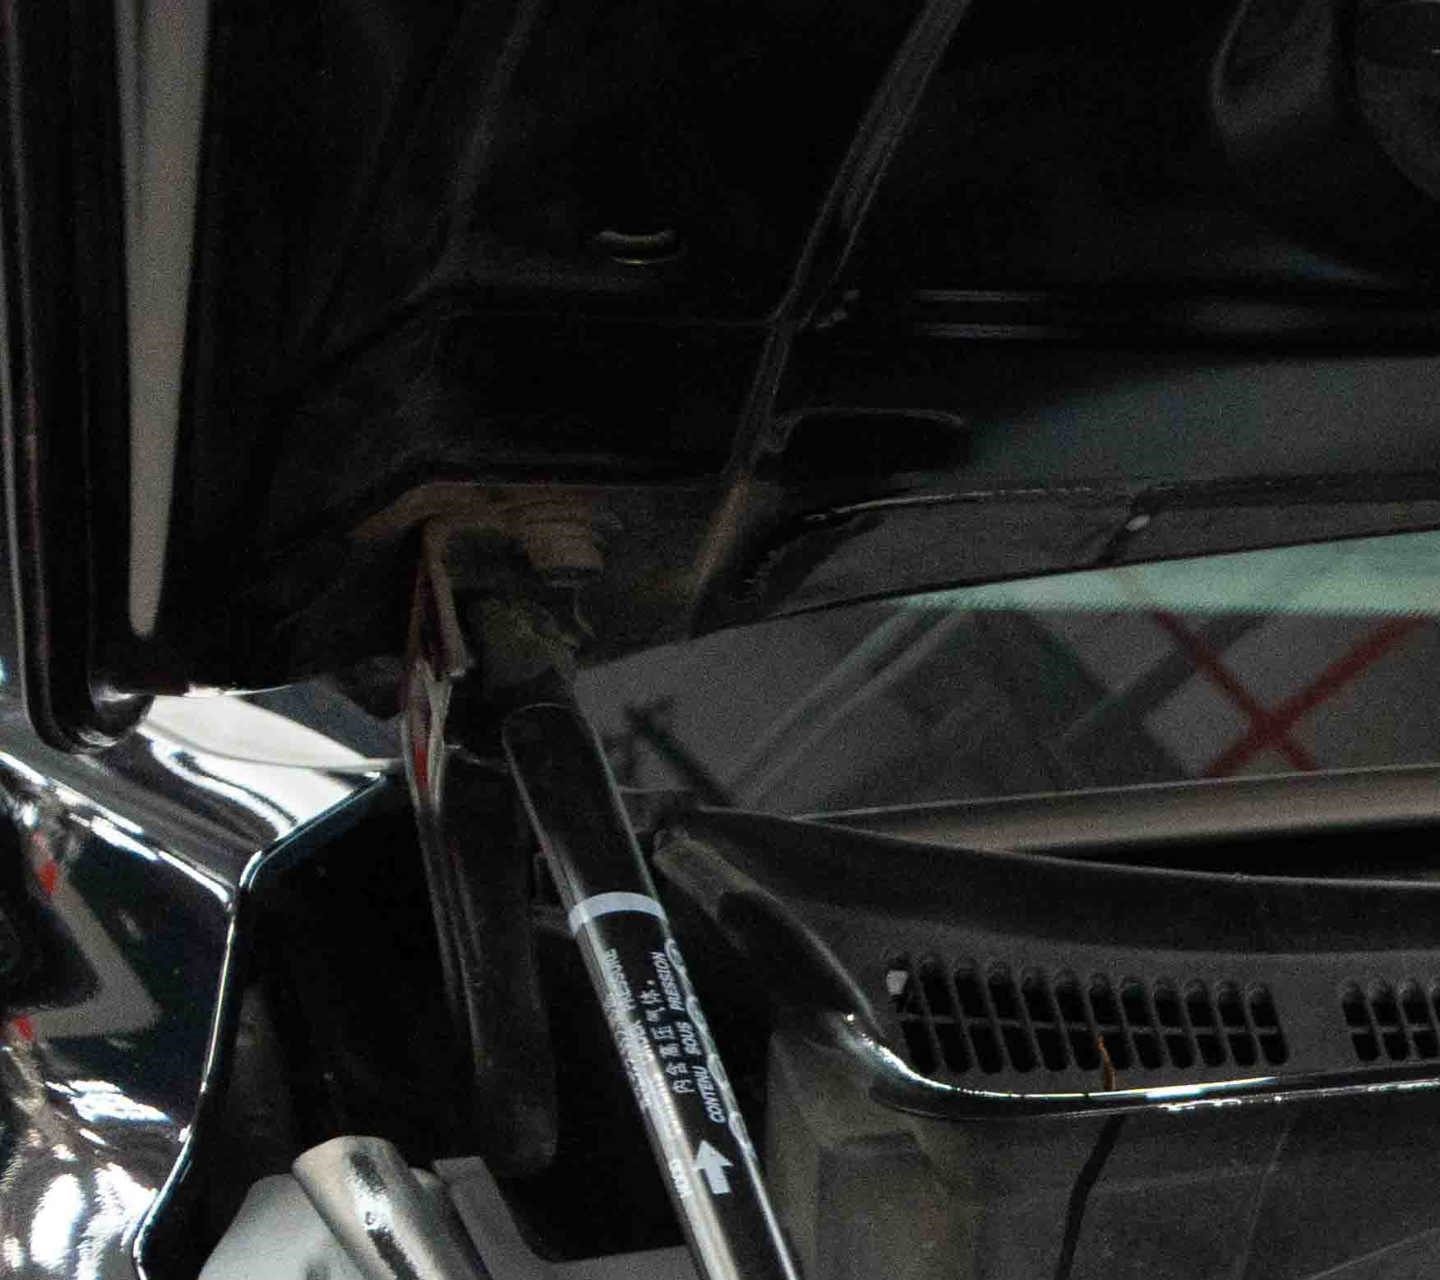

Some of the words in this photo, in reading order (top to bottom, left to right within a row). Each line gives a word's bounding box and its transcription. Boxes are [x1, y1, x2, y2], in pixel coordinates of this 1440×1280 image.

[604, 947, 635, 1012] PRESSURE
[650, 951, 685, 1011] PRESSION
[674, 1021, 701, 1055] SOUS
[691, 1064, 727, 1123] CONTENU
